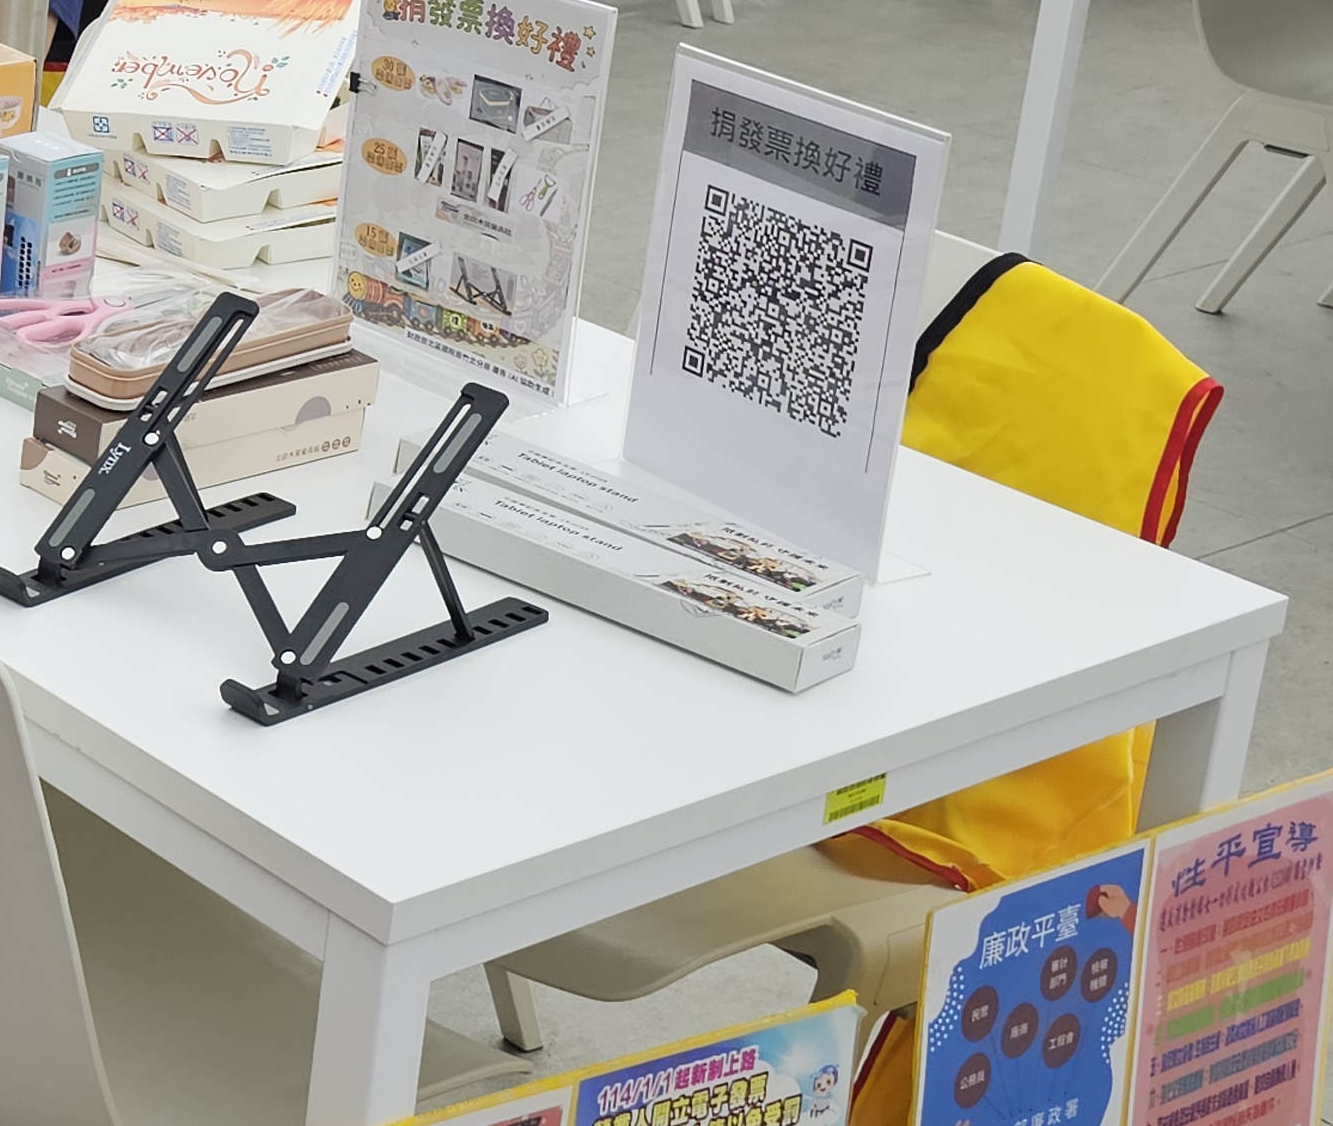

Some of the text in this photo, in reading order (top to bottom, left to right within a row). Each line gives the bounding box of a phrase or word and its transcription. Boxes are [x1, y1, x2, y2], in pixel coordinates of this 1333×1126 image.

[374, 142, 386, 155] 25
[710, 106, 885, 197] 捐發票換好禮
[366, 224, 377, 238] 15
[97, 441, 132, 475] Lynx
[517, 451, 639, 504] Tablet laptop stand
[494, 499, 623, 552] Tablet laptop stand
[1171, 821, 1319, 897] 性平宣導
[979, 903, 1082, 969] 廉政平臺
